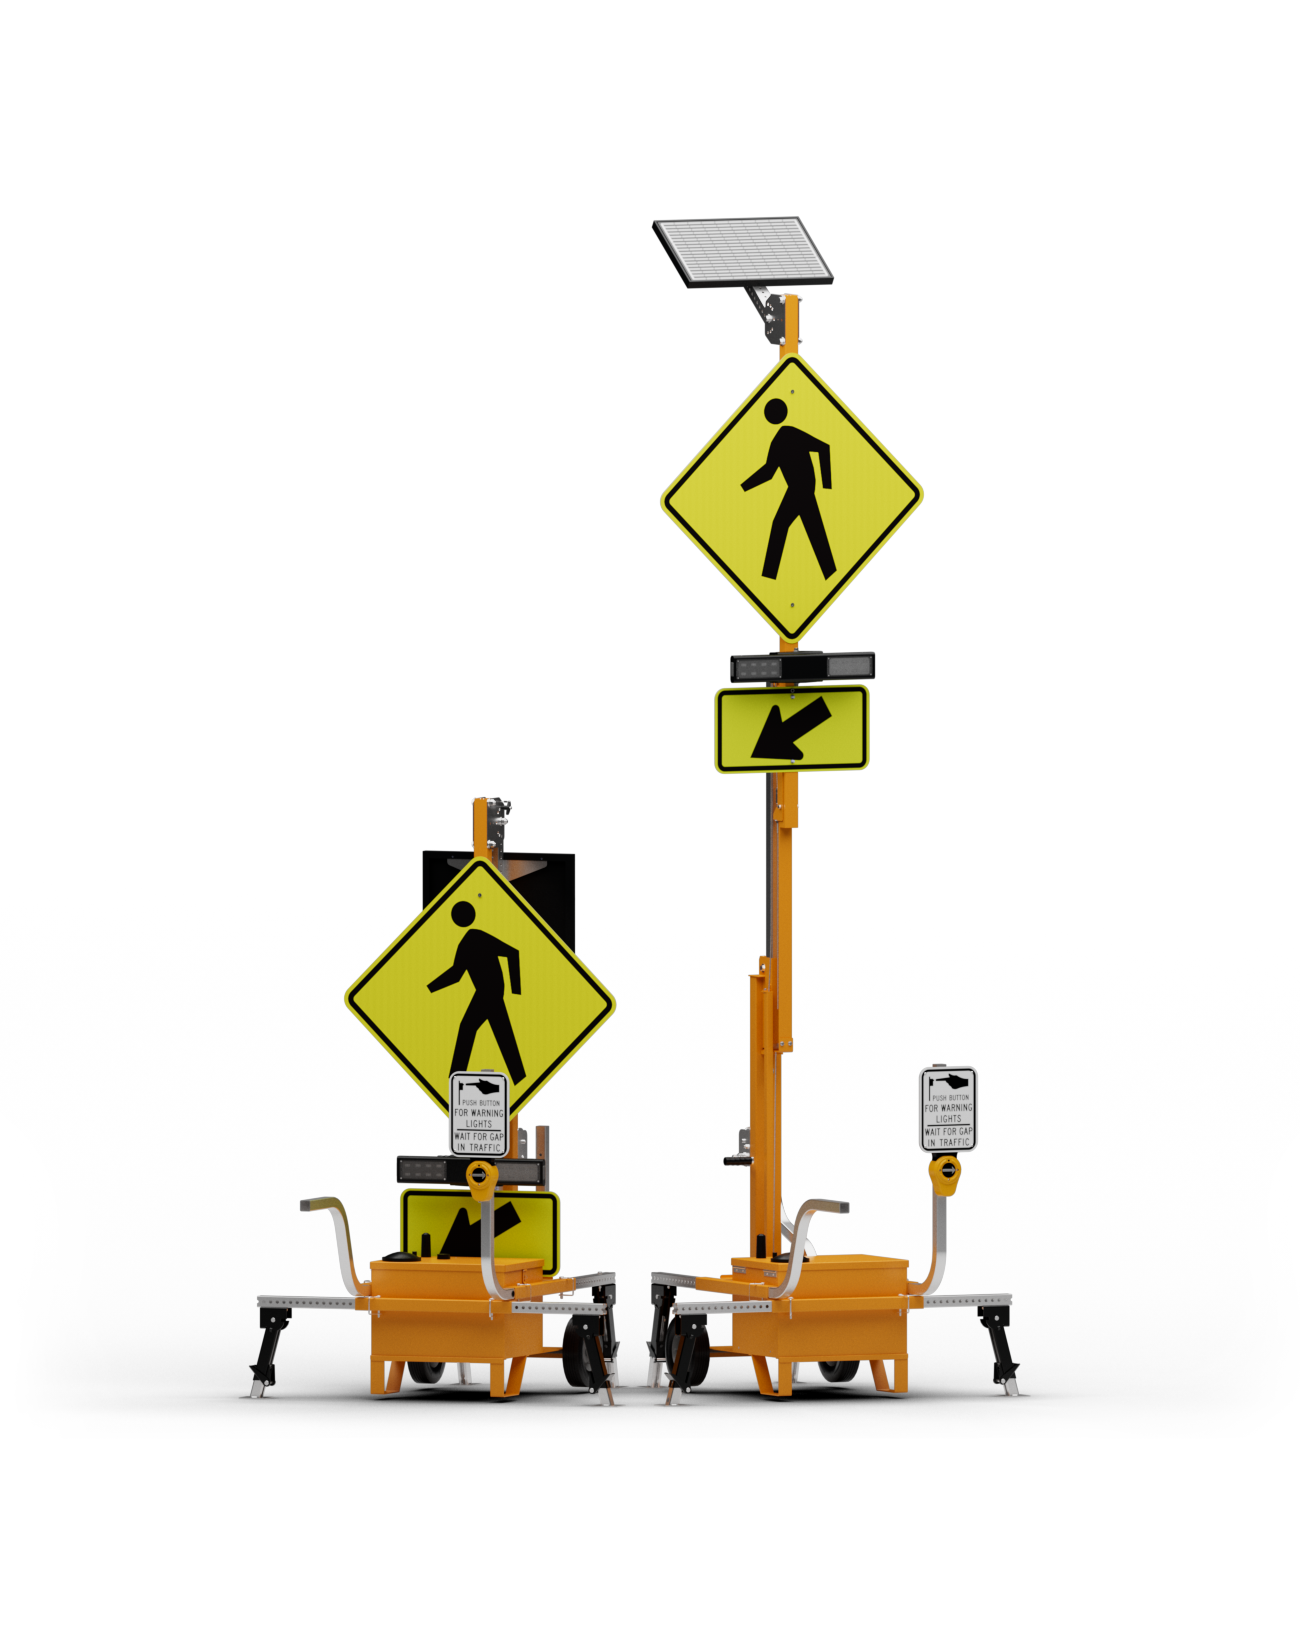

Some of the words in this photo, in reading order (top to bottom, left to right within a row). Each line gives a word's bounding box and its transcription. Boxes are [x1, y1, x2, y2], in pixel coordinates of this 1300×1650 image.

[941, 1103, 972, 1112] WARNING
[471, 1109, 503, 1117] WARNING
[936, 1115, 961, 1123] LIGHTS
[466, 1120, 492, 1128] LIGHTS
[925, 1128, 940, 1136] WAIT
[943, 1127, 956, 1135] FOR
[959, 1127, 973, 1135] GAP
[940, 1138, 969, 1146] TRAFFIC
[470, 1144, 500, 1152] TRAFFIC
